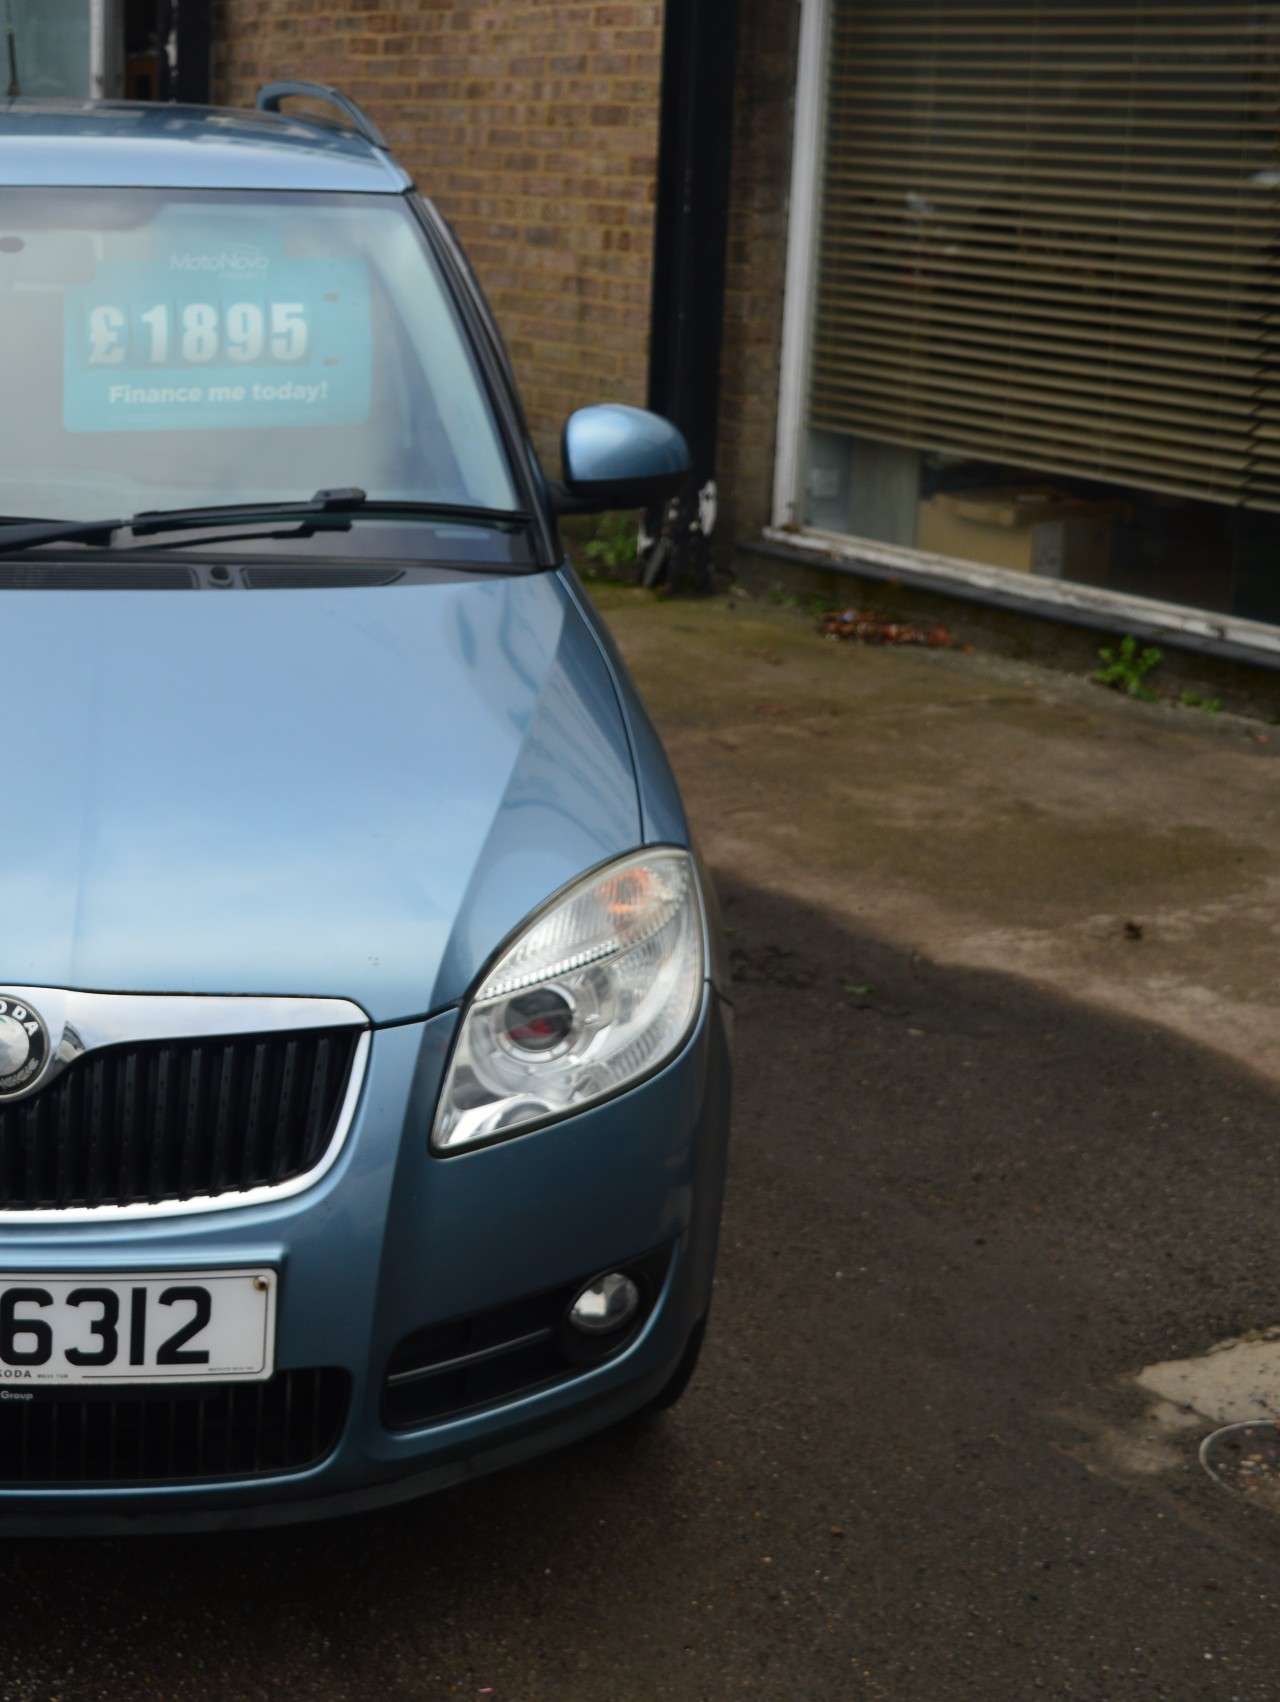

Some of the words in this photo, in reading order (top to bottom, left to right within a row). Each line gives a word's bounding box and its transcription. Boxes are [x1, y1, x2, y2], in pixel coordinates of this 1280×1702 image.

[109, 384, 202, 404] Finance
[208, 385, 246, 401] me
[251, 380, 328, 403] today!
[0, 1390, 33, 1400] Group
